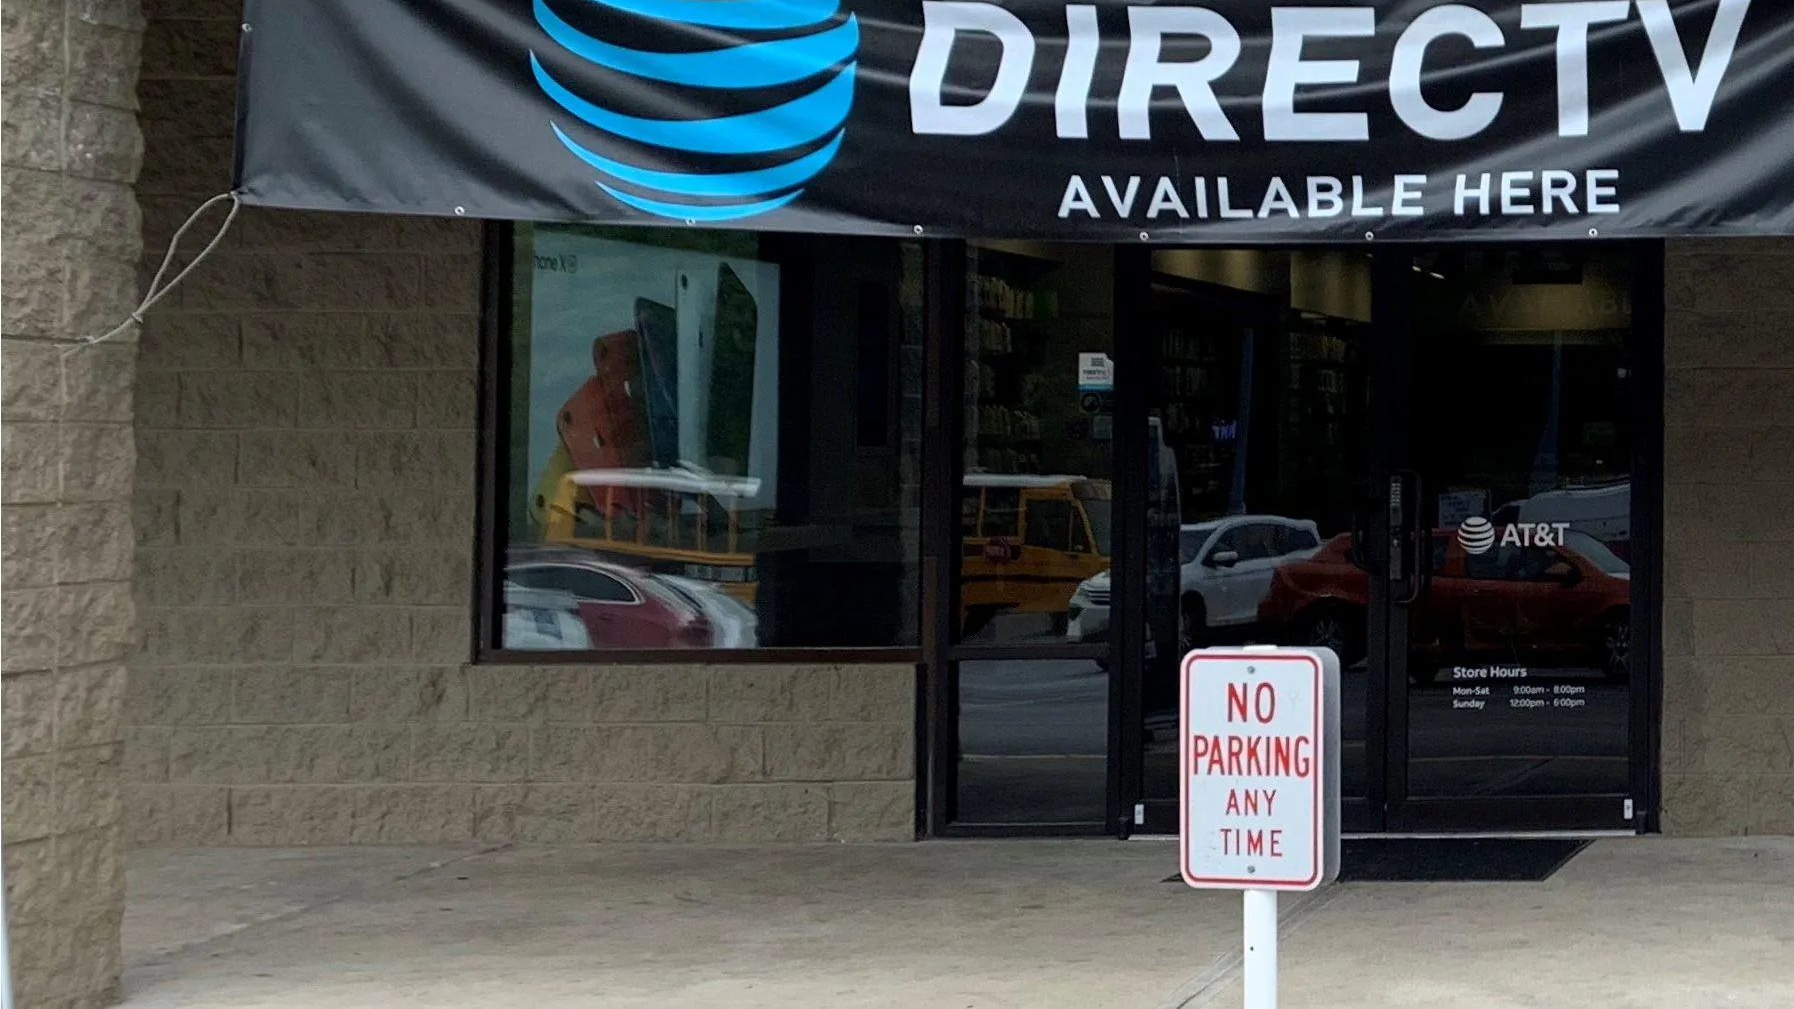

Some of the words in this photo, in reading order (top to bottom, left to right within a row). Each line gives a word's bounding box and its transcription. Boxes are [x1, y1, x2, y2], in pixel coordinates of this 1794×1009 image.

[1056, 172, 1428, 220] AVAILABLE
[1454, 169, 1621, 216] HERE
[1500, 522, 1570, 547] AT&T
[1453, 666, 1487, 679] Store
[1490, 666, 1527, 678] Hours
[1227, 682, 1276, 724] NO
[1453, 686, 1490, 696] Mon-Sat
[1453, 699, 1485, 710] Sunday
[1193, 734, 1310, 778] PARKING
[1225, 788, 1277, 817] ANY
[1220, 828, 1283, 857] TIME
